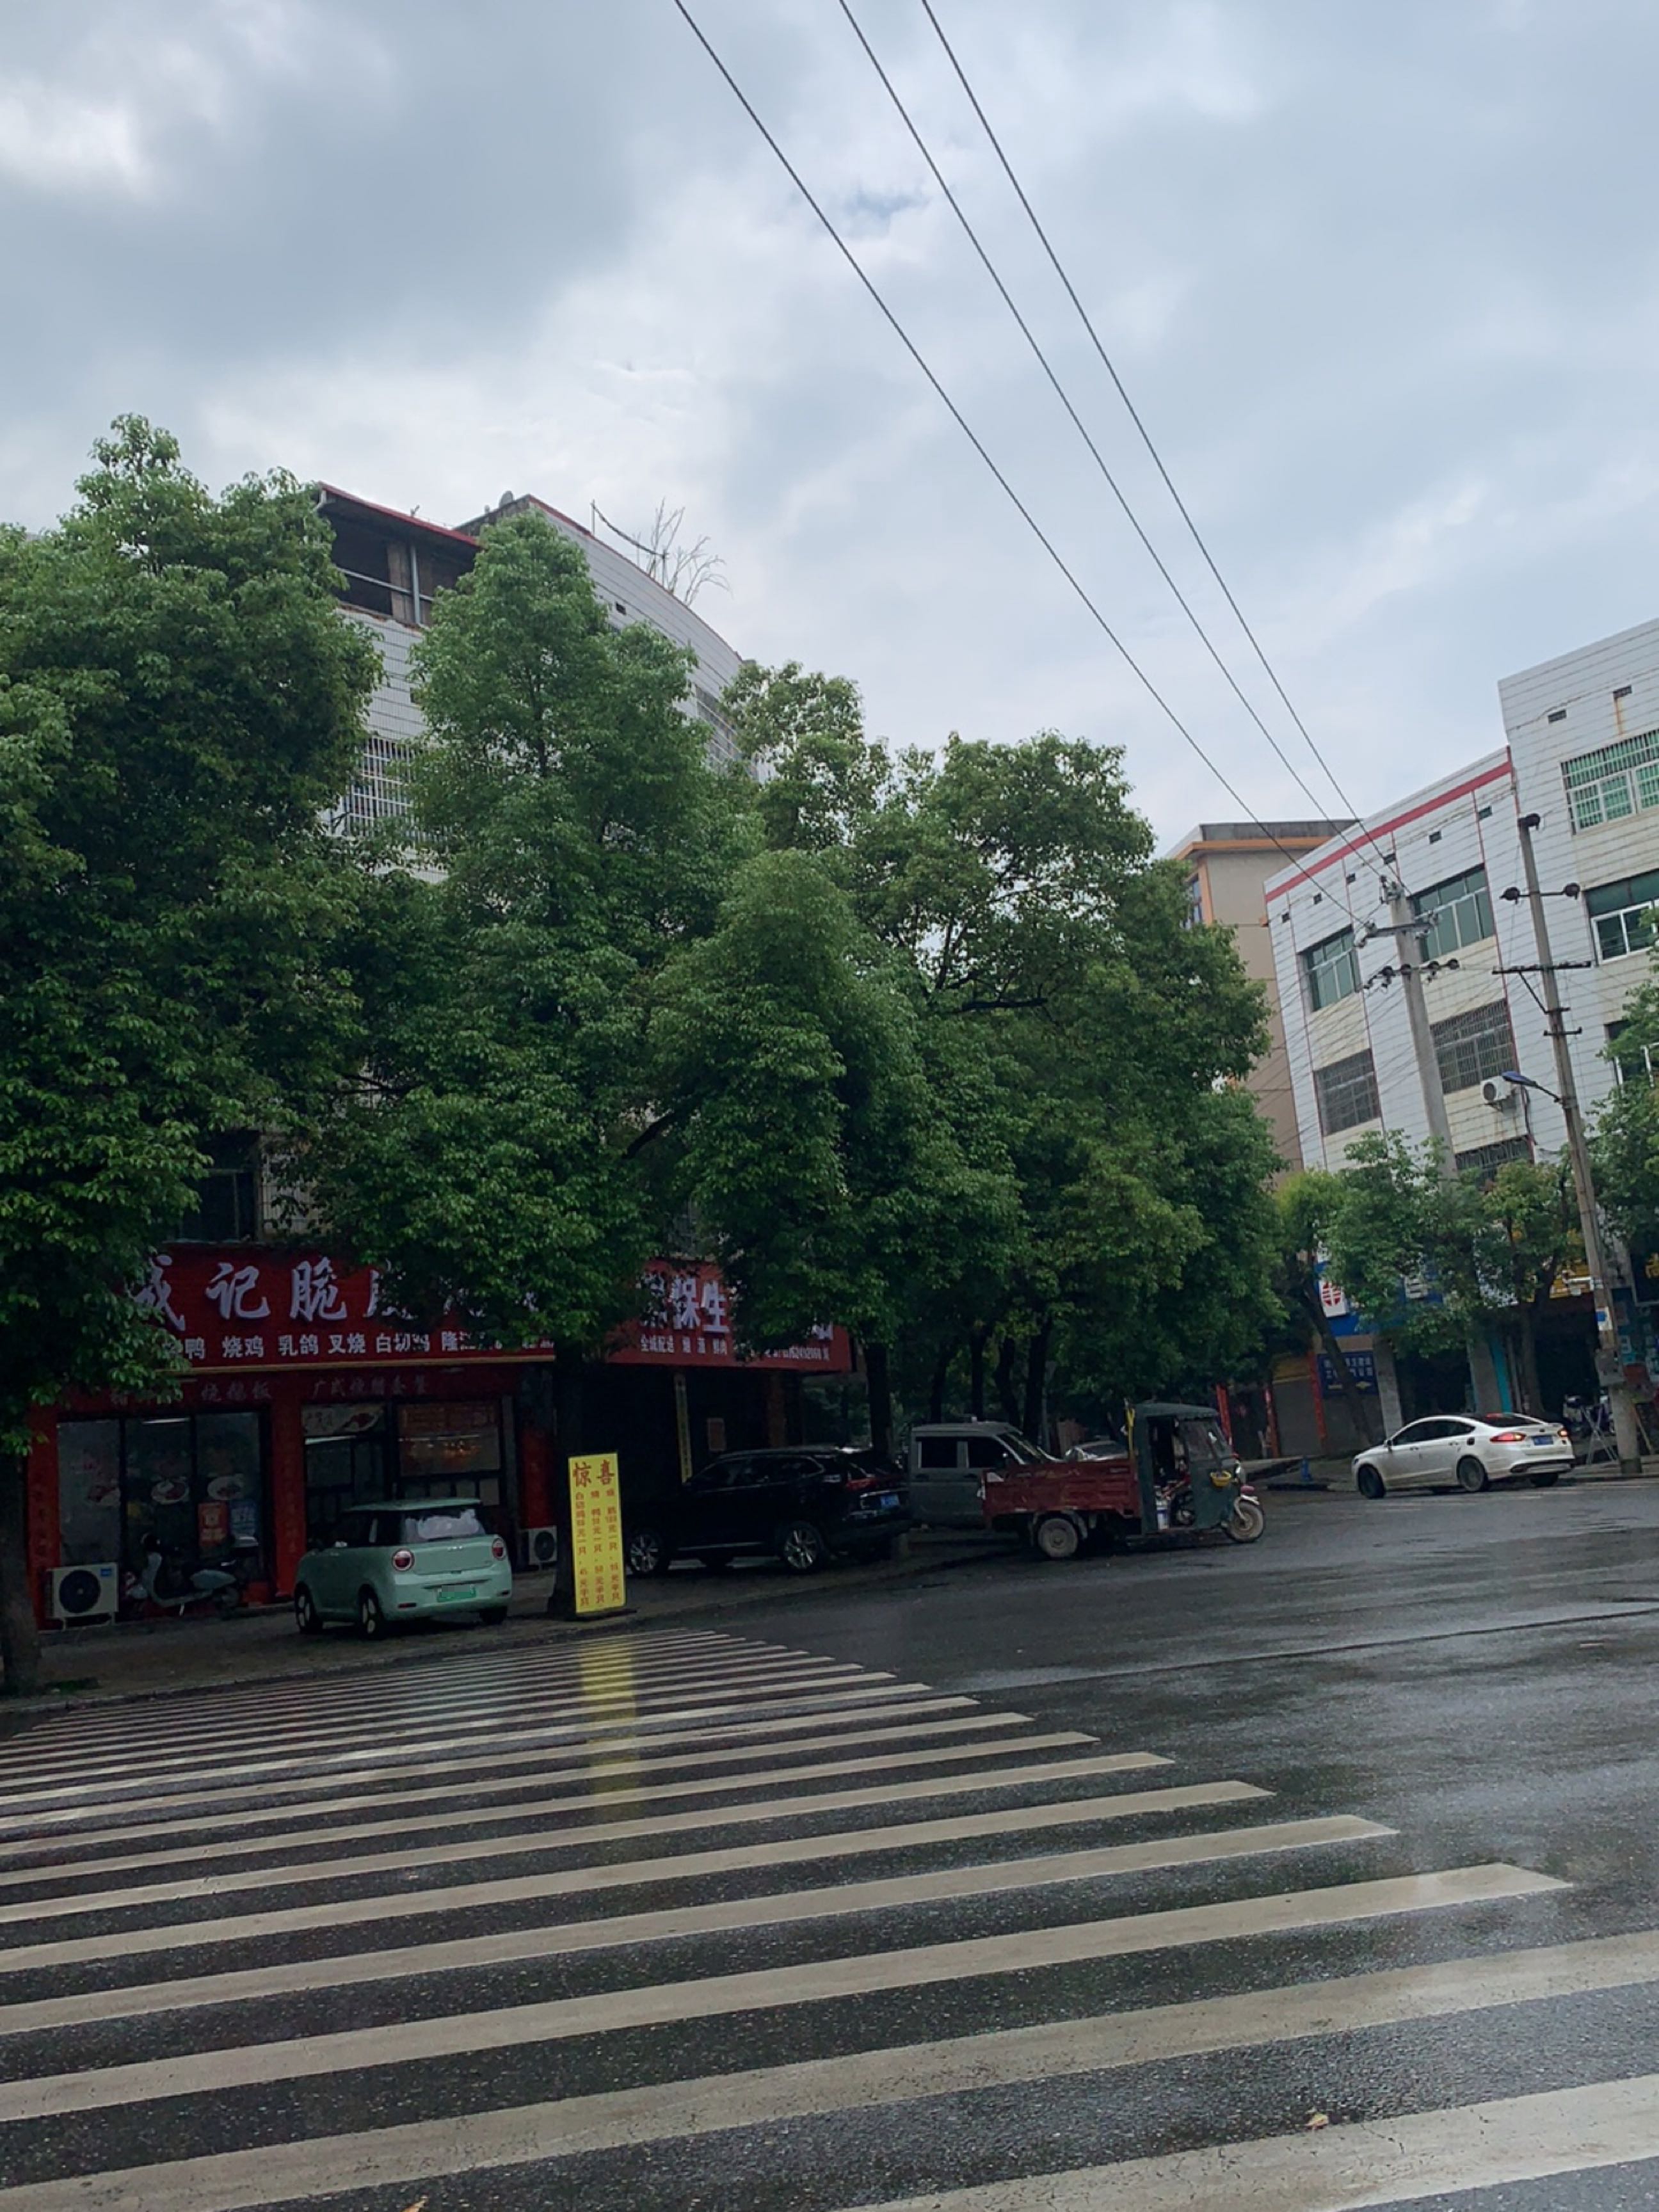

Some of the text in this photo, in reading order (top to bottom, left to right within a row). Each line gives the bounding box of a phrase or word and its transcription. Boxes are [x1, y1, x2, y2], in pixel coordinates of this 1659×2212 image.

[221, 1334, 264, 1358] 烧鸡
[278, 1333, 319, 1356] 乳鸽
[327, 1332, 366, 1354] 叉烧
[573, 1459, 615, 1488] 惊喜
